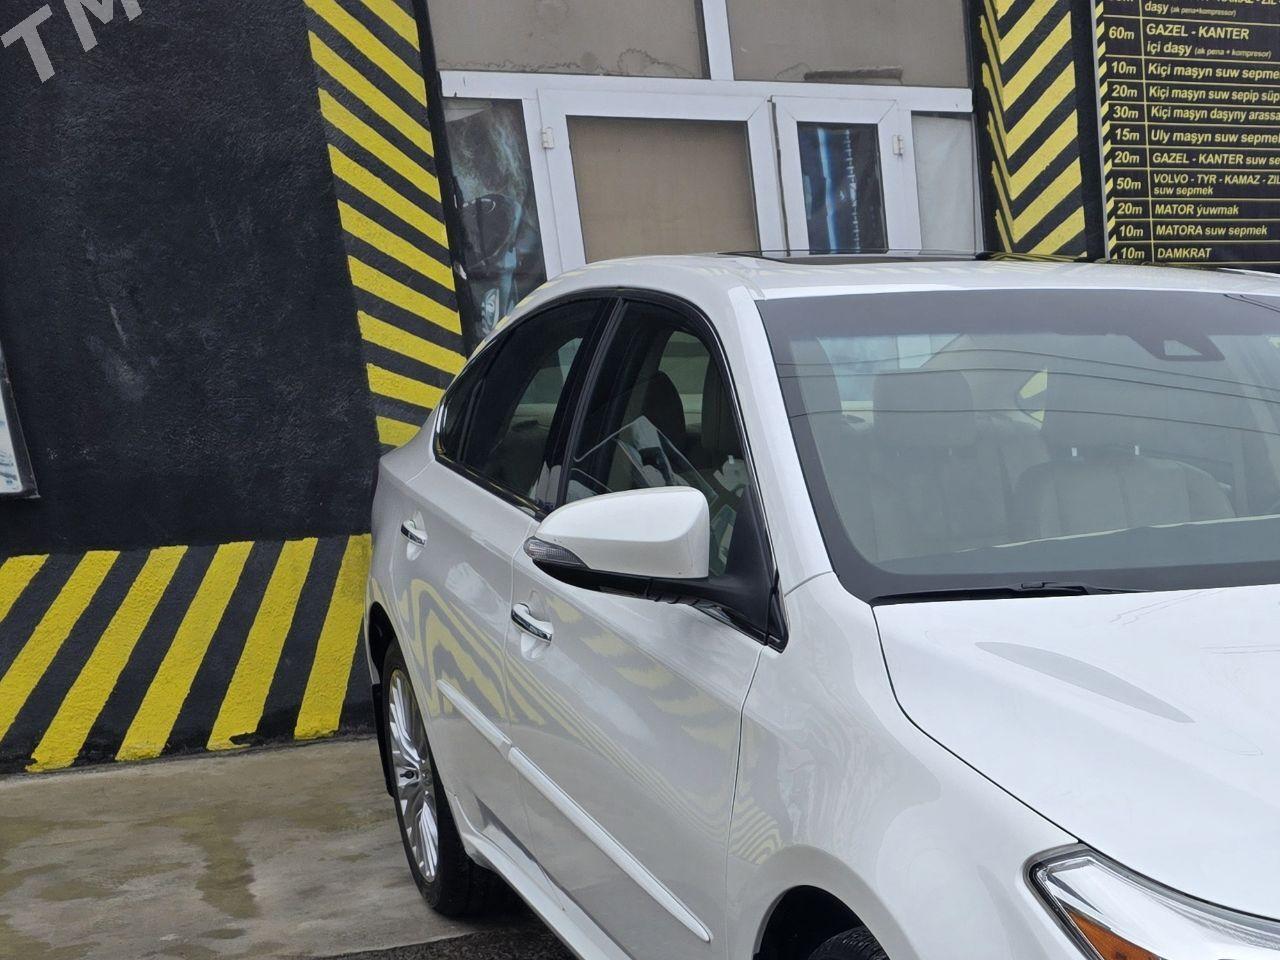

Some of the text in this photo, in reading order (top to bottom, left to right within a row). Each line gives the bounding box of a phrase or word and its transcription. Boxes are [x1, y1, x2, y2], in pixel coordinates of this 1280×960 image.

[1145, 1, 1169, 15] daşy
[1109, 26, 1135, 40] 60m
[1146, 23, 1188, 38] GAZEL
[1199, 25, 1250, 40] KANTER
[1147, 41, 1161, 55] içi
[1163, 42, 1192, 56] daşy
[1111, 61, 1136, 74] 10m
[1148, 62, 1171, 76] Kiçi
[1174, 66, 1213, 79] maşyn
[1216, 68, 1239, 78] suw
[1111, 84, 1137, 98] 20m
[1149, 85, 1170, 99] Kiçi
[1172, 88, 1206, 102] maşyn
[1209, 91, 1229, 100] suw
[1232, 90, 1259, 103] sepip
[1113, 105, 1138, 119] 30m
[1151, 106, 1171, 120] Kiçi
[1174, 109, 1206, 123] maşyn
[1210, 108, 1246, 123] daşyny
[1115, 128, 1140, 141] 15m
[1151, 129, 1169, 144] Uly
[1173, 131, 1212, 145] maşyn
[1215, 133, 1238, 143] suw
[1114, 152, 1140, 164] 20m
[1152, 152, 1190, 164] GAZEL
[1199, 152, 1243, 164] KANTER
[1246, 156, 1267, 165] suw
[1116, 177, 1142, 190] 50m
[1154, 173, 1188, 184] VOLVO
[1197, 174, 1217, 184] TYR
[1224, 174, 1260, 185] KAMAZ
[1154, 185, 1213, 197] suw sepmek
[1117, 202, 1143, 215] 20m
[1155, 203, 1239, 217] MATOR ýuwmak
[1119, 224, 1143, 237] 10m
[1156, 224, 1268, 238] MATORA suw sepmek
[1120, 247, 1145, 259] 10m
[1157, 247, 1212, 258] DAMKRAT
